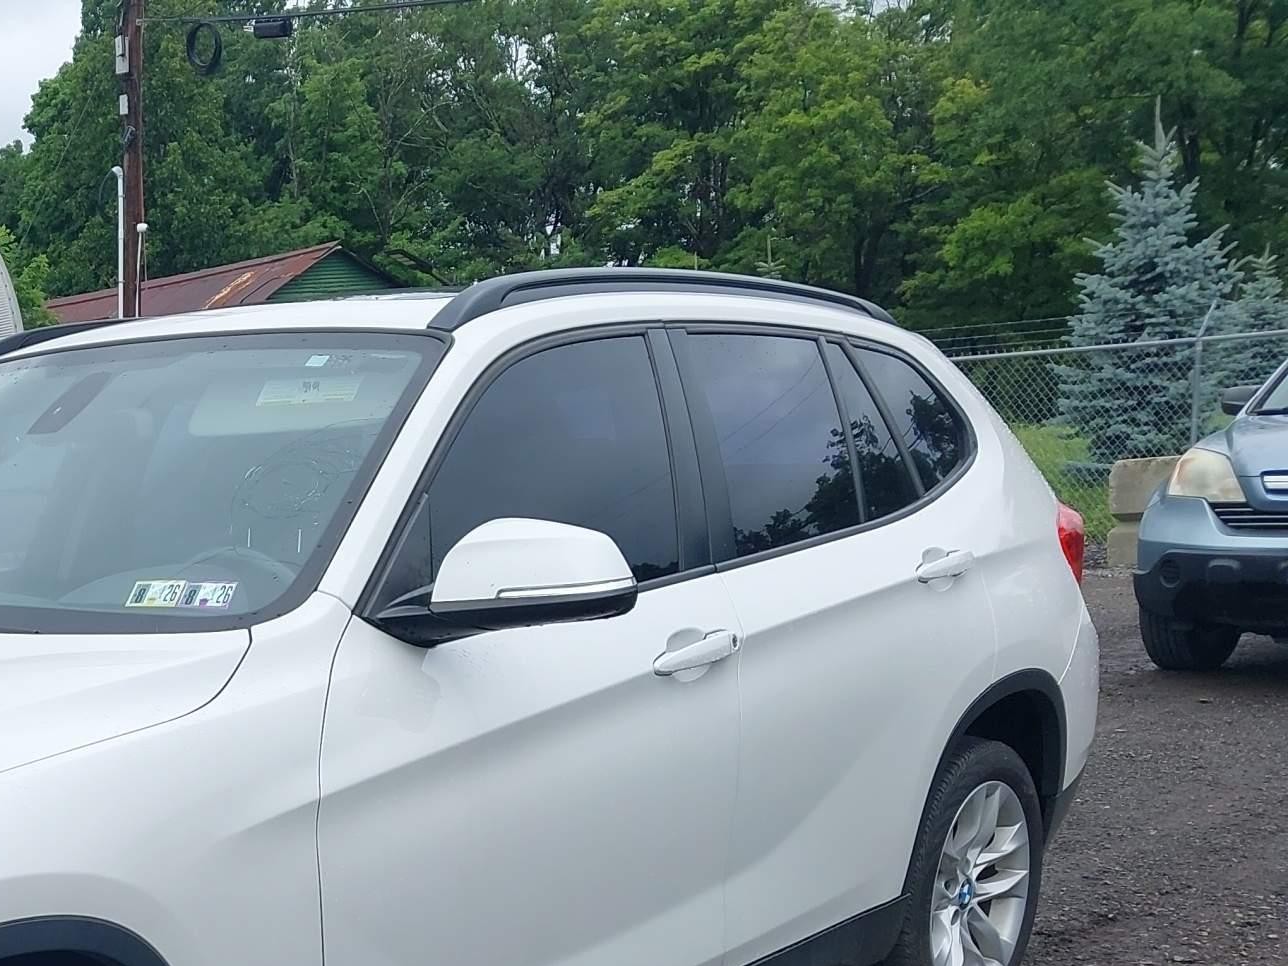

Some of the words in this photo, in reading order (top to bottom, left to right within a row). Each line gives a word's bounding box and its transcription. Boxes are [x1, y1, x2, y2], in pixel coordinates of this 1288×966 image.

[135, 588, 146, 603] 8
[163, 584, 181, 602] 26
[185, 589, 196, 605] 8
[216, 585, 233, 604] 26
